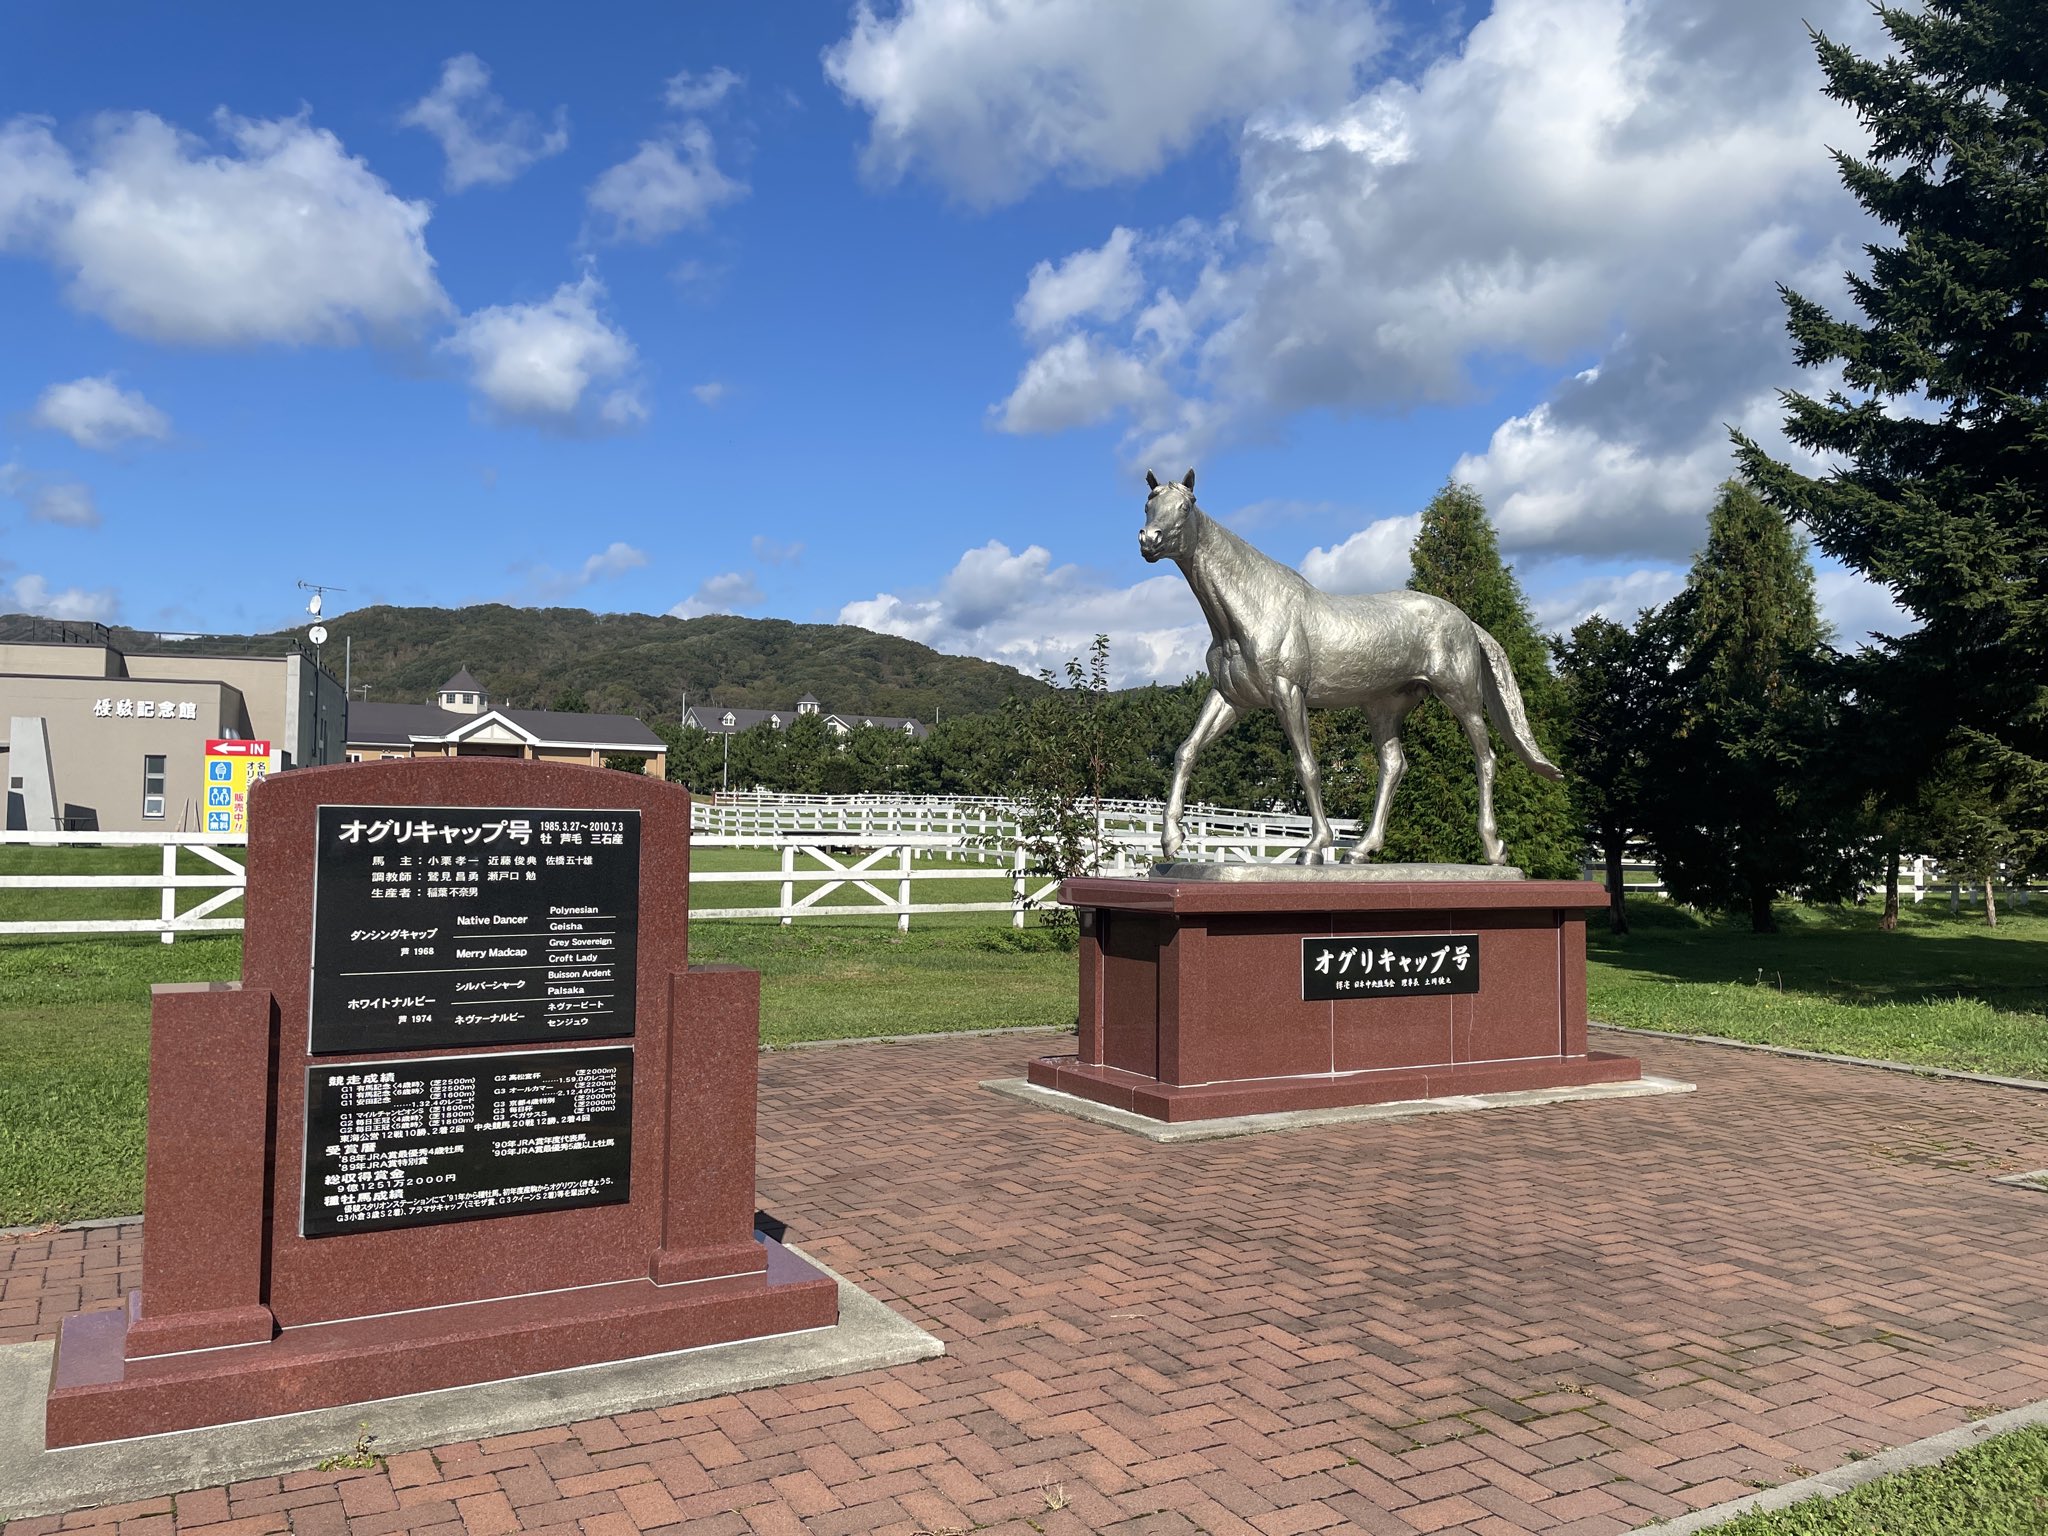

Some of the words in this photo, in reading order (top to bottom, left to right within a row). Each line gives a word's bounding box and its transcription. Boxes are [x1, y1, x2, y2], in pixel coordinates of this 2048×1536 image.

[93, 698, 197, 720] 優駿記念館
[250, 743, 264, 755] IN
[209, 813, 229, 821] 入場
[209, 822, 229, 830] 無料
[338, 819, 533, 846] オグリキャップ号
[540, 833, 552, 845] 牡
[560, 833, 582, 845] 芦毛
[590, 833, 623, 845] 三石産
[545, 855, 593, 866] 佐橋五十雄
[549, 905, 599, 915] Polynesian
[457, 915, 490, 926] Native
[493, 914, 529, 925] Dancer
[549, 921, 583, 931] Geisha
[350, 927, 438, 941] ダンシングキャップ
[549, 938, 569, 947] Grey
[571, 936, 613, 947] Sovereign
[400, 947, 410, 956] 芦
[413, 947, 435, 956] 1968
[456, 948, 487, 960] Merry
[488, 947, 528, 959] Madcap
[548, 953, 573, 963] Croft
[576, 952, 599, 963] Lady
[1314, 944, 1471, 975] オグリキャップ号
[548, 969, 580, 979] Buisson
[582, 968, 612, 978] Ardent
[455, 979, 526, 992] シルバーシャーク
[347, 996, 436, 1010] ホワイトナルビー
[547, 1000, 605, 1011] ネヴァービート
[398, 1015, 408, 1024] 芦
[411, 1014, 432, 1024] 1974
[454, 1012, 525, 1025] ネヴァーナルビー
[547, 1017, 589, 1027] センジュウ
[328, 1072, 395, 1087] 競走成績
[508, 1072, 542, 1082] 高松宮杯
[508, 1085, 554, 1094] オールカマー
[356, 1097, 391, 1106] 安田記念
[356, 1108, 425, 1119] マイルチャンピオンS
[493, 1107, 505, 1115] G3
[509, 1105, 533, 1114] 毎日杯
[509, 1110, 548, 1119] ペガサスS
[339, 1132, 380, 1143] 東海公営
[474, 1121, 511, 1132] 中央競馬
[324, 1168, 405, 1186] 総収得賞金
[323, 1189, 404, 1207] 種牡馬成績
